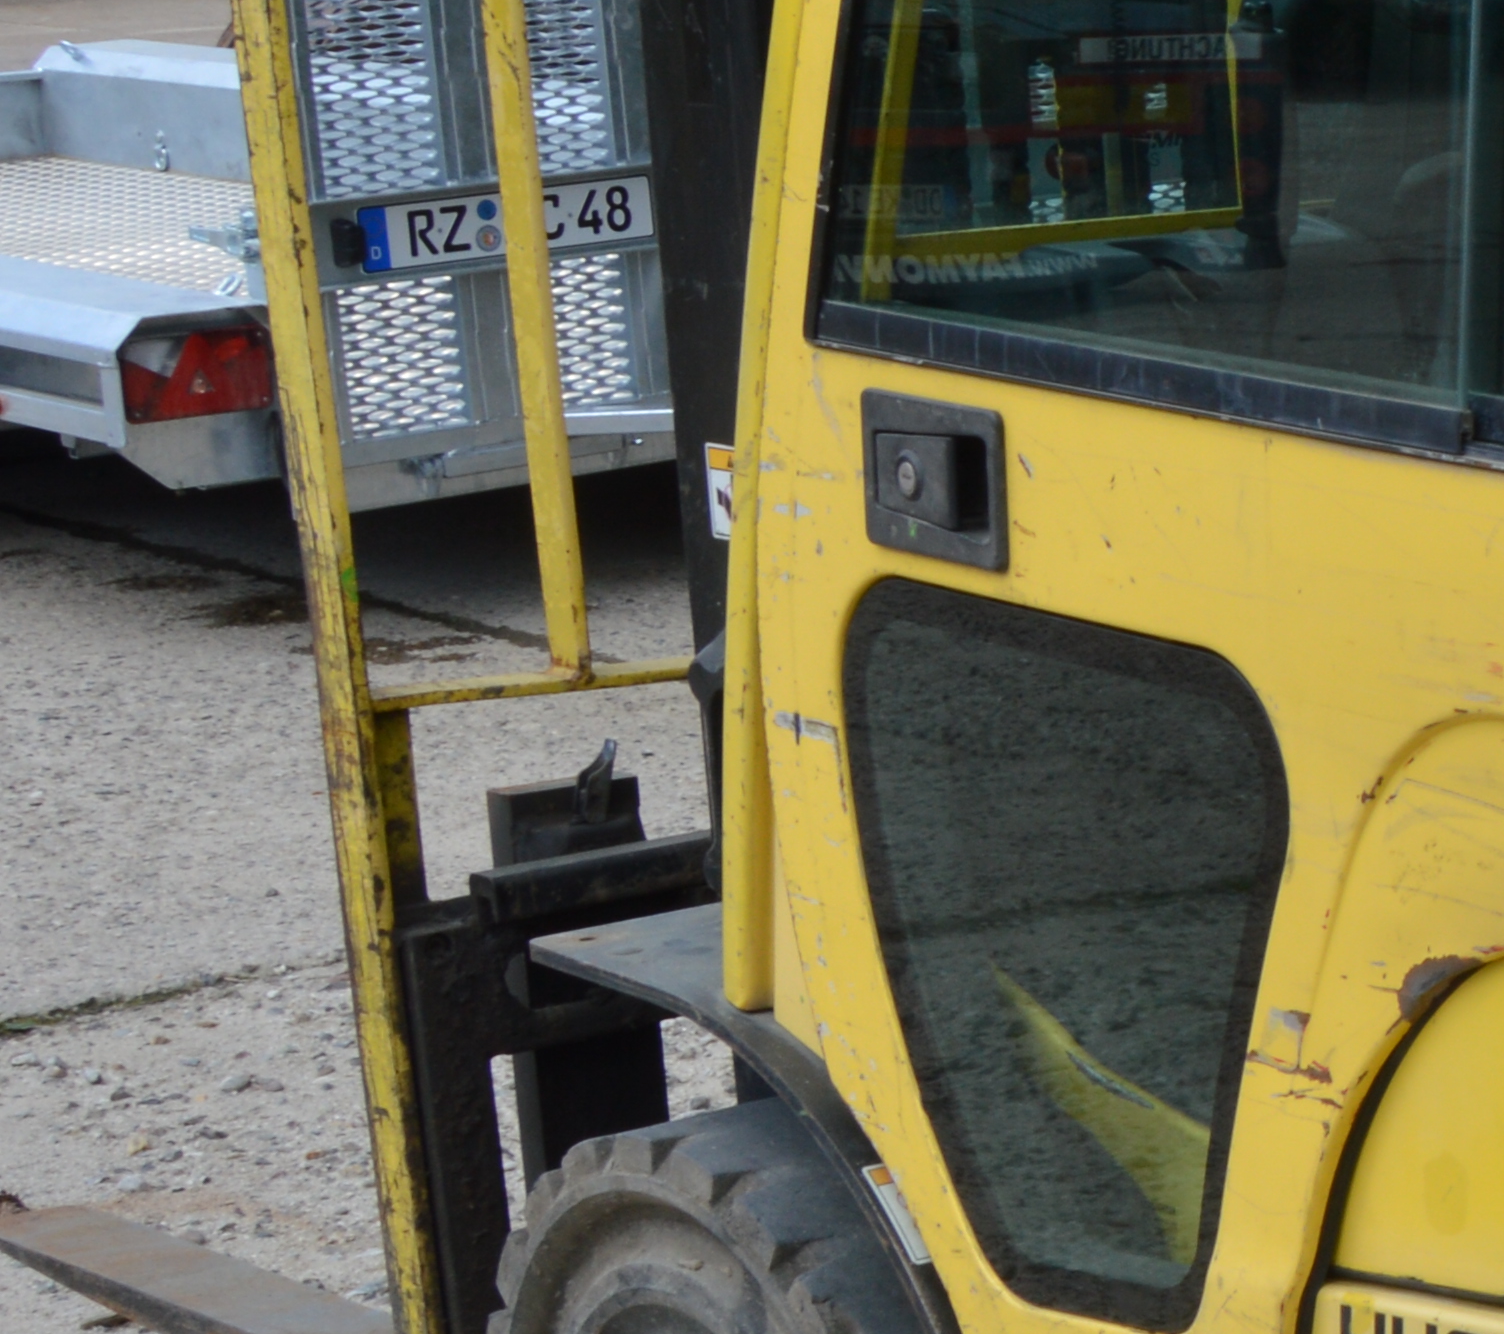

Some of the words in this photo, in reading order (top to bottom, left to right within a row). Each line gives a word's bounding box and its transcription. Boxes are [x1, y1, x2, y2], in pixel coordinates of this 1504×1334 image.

[371, 246, 383, 261] D
[406, 204, 472, 257] RZ
[577, 185, 632, 235] 48
